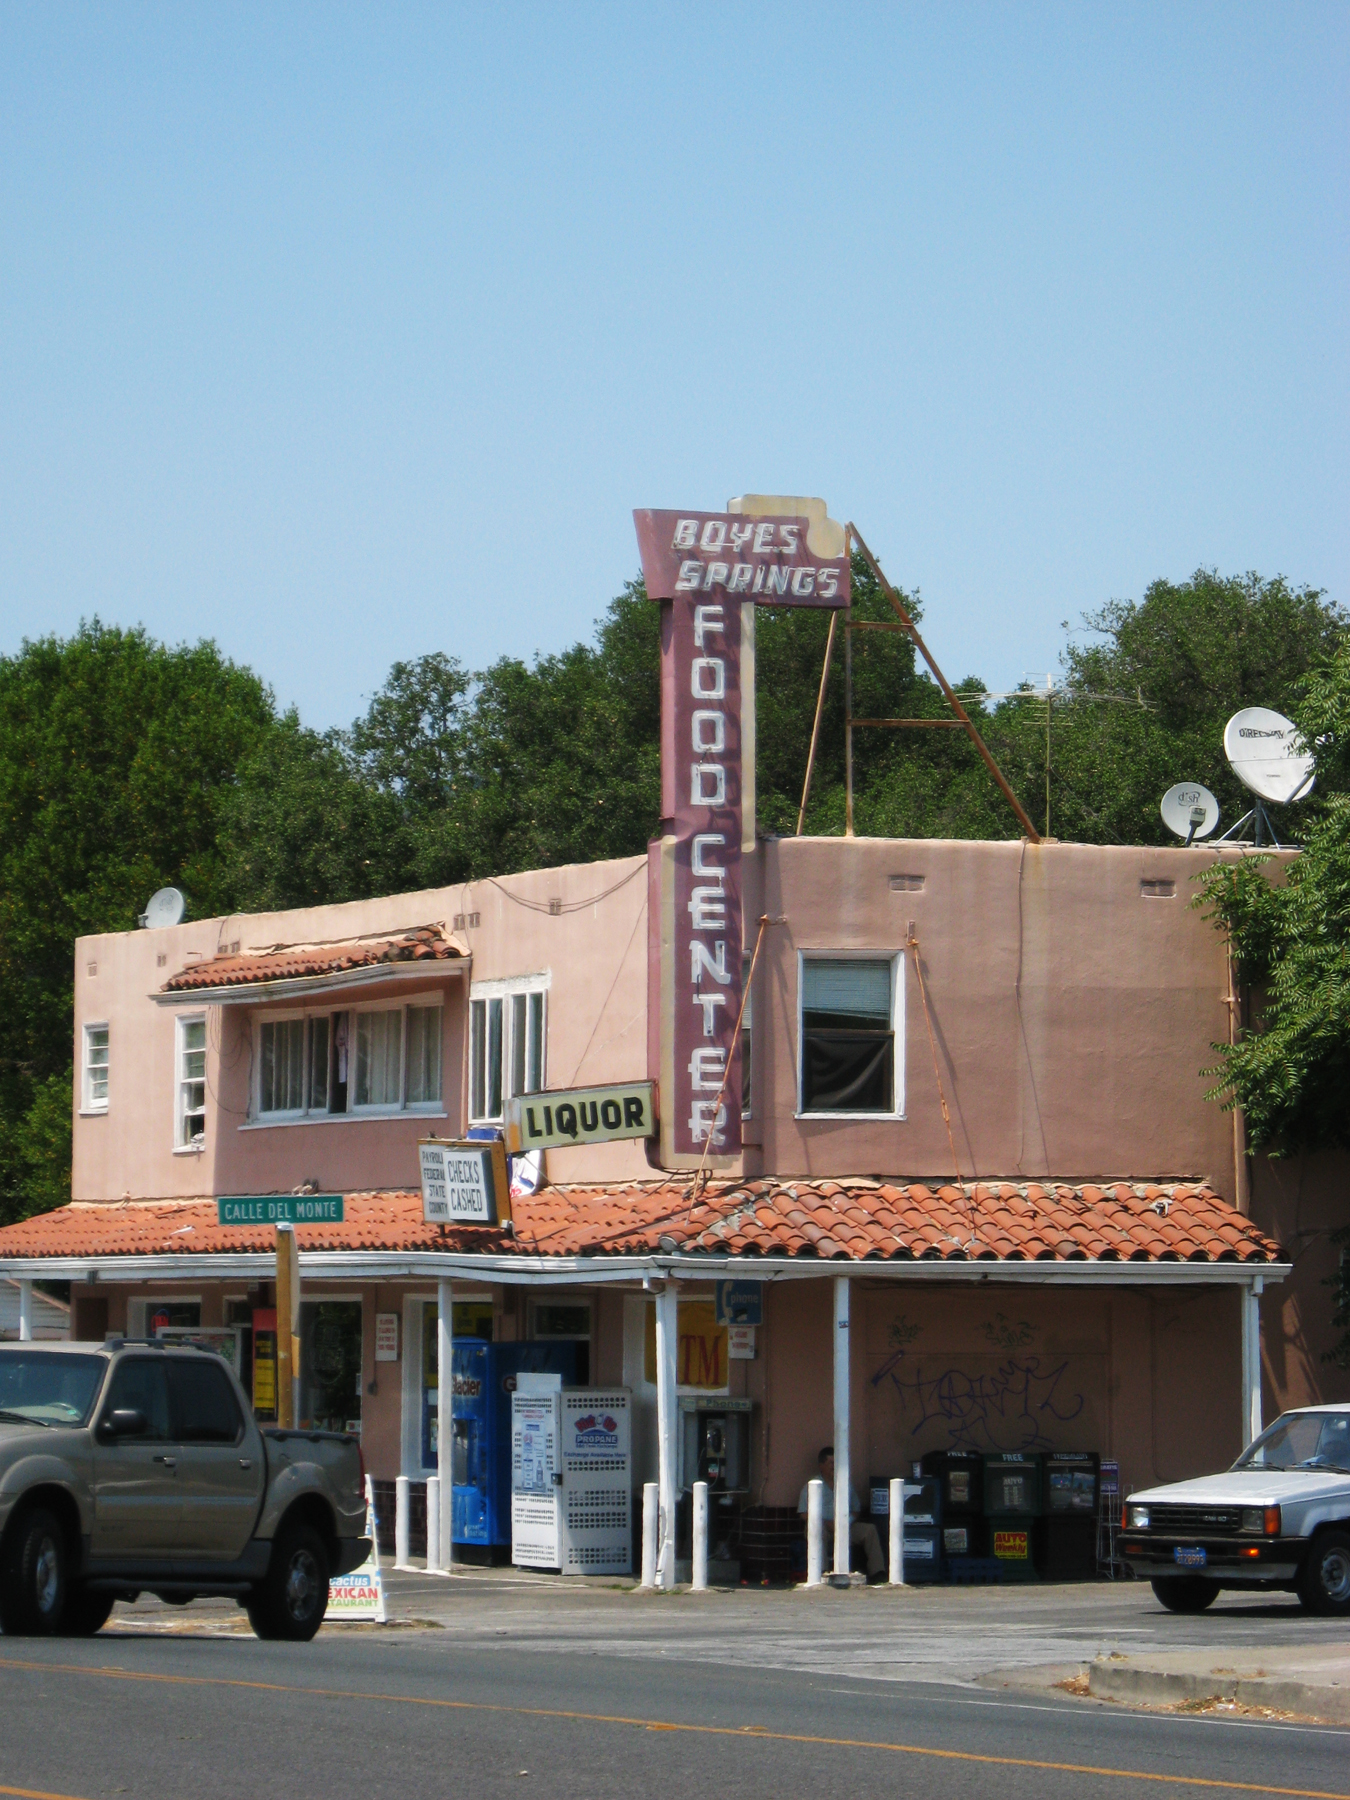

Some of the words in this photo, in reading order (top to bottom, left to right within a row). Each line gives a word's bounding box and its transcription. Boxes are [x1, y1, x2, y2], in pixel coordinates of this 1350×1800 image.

[671, 519, 800, 553] BOYES
[675, 560, 840, 597] SPRINGS
[691, 605, 725, 806] FOOD
[688, 833, 731, 1146] CENTER
[526, 1096, 644, 1139] LIQUOR
[447, 1160, 480, 1184] CHECKS
[429, 1184, 446, 1198] STATE
[450, 1188, 483, 1212] CASHED
[224, 1202, 263, 1220] CALLE
[268, 1202, 292, 1219] DEL
[296, 1201, 337, 1218] MONTE
[428, 1201, 448, 1214] COUNTY
[730, 1292, 759, 1304] phone
[680, 1334, 721, 1385] TM
[451, 1376, 481, 1397] lacier
[576, 1435, 617, 1443] PROPANE
[1002, 1454, 1024, 1462] FREE
[996, 1533, 1027, 1543] AUTO
[328, 1587, 378, 1599] EXICAN
